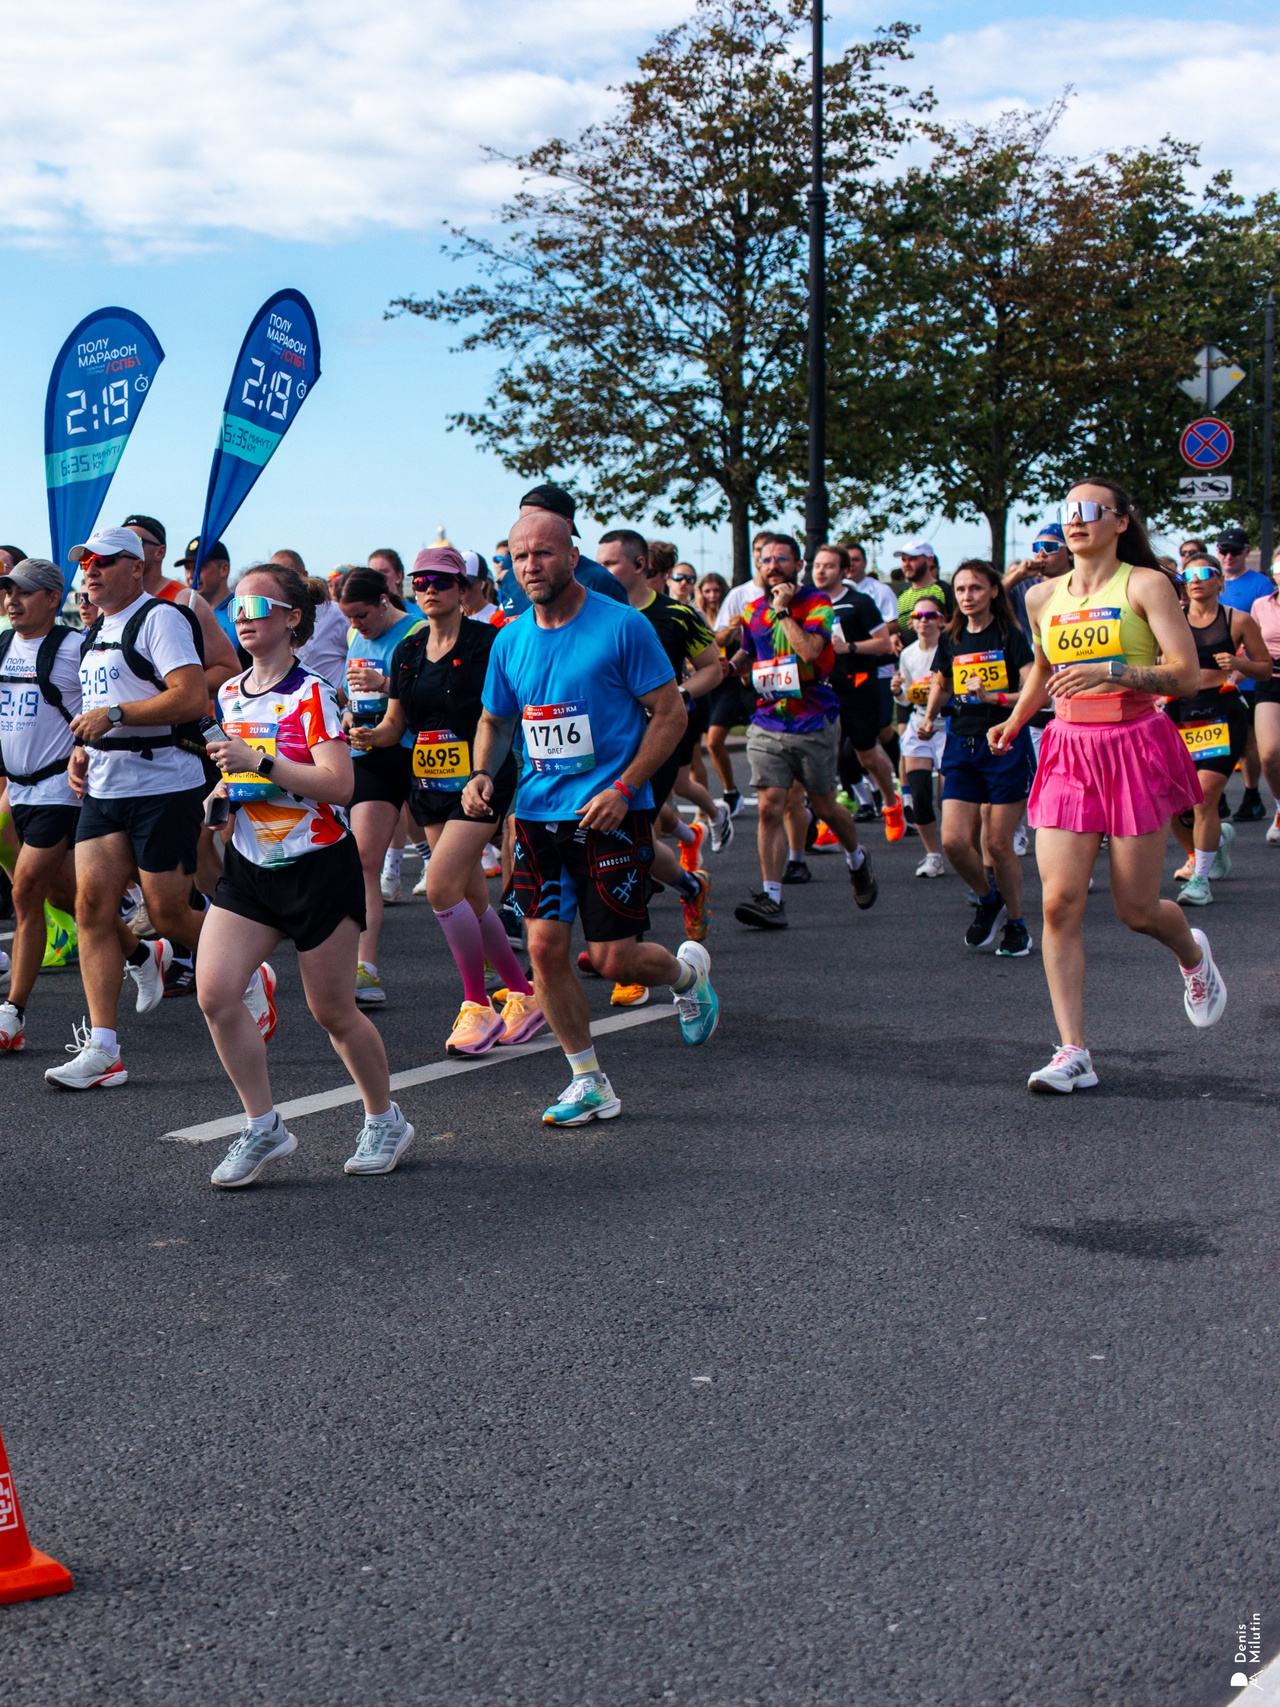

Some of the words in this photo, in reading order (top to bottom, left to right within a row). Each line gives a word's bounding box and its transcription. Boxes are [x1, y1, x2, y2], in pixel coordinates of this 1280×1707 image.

[270, 313, 292, 332] ПОЛУ
[78, 338, 109, 355] ПОЛУ
[267, 327, 307, 356] МАРАФОН
[78, 344, 137, 368] МАРАФОН
[242, 357, 292, 420] 2:19
[66, 379, 128, 435] 2:19
[61, 454, 90, 477] 6:35
[92, 460, 104, 470] КМ
[1058, 626, 1109, 650] 6690
[4, 664, 36, 672] МАРАФО
[960, 666, 1000, 684] 235
[758, 671, 792, 688] 7716
[0, 690, 39, 716] 2:19
[552, 707, 564, 715] 21,1
[530, 722, 581, 746] 1716
[1185, 728, 1222, 745] 5609
[416, 747, 460, 767] 3695
[535, 760, 542, 772] E
[421, 779, 428, 788] E
[599, 856, 630, 868] HARDCORE
